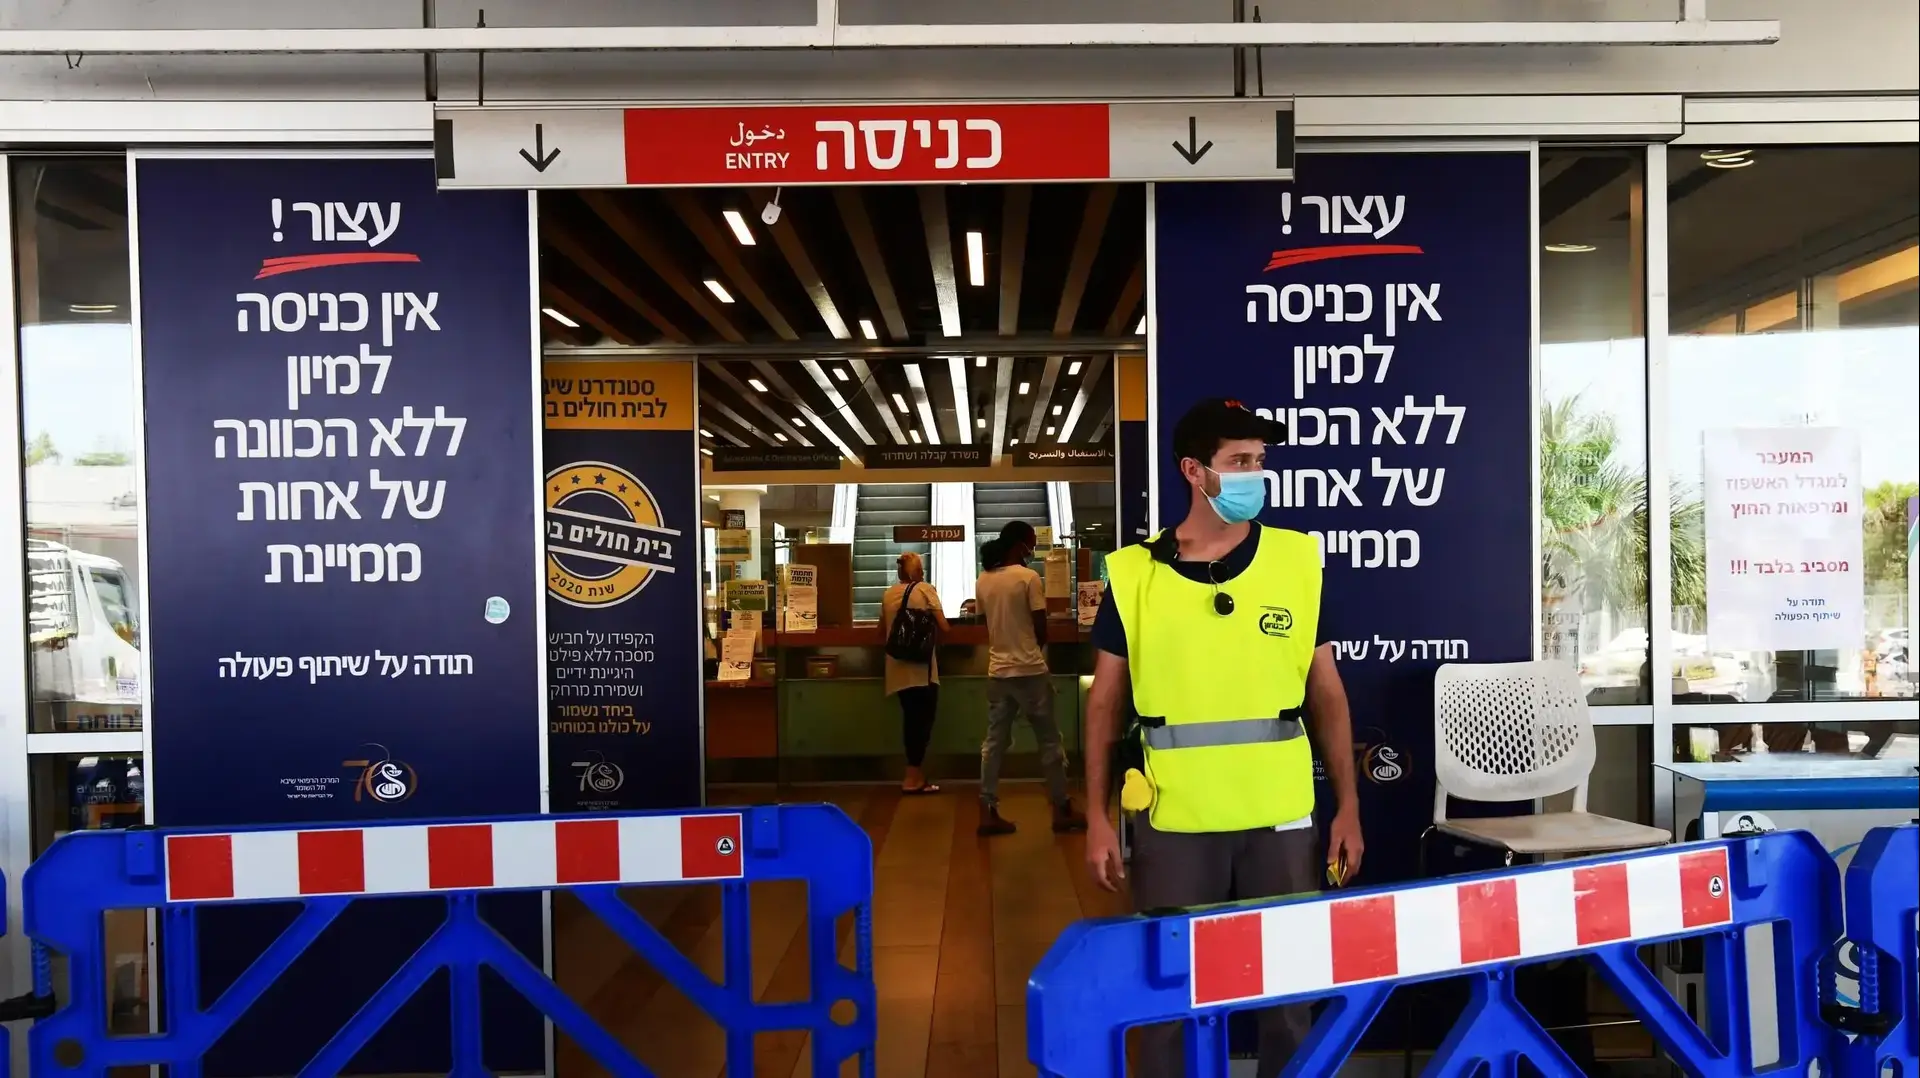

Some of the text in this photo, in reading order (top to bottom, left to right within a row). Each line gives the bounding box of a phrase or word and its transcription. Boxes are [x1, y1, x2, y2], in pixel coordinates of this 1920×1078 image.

[730, 121, 786, 147] دخول
[815, 118, 1003, 170] כניסה
[725, 152, 790, 170] ENTRY
[292, 202, 401, 247] עצור
[1301, 195, 1406, 240] עצור
[236, 292, 441, 346] אין כניסה
[1245, 283, 1443, 337] אין כניסה
[287, 343, 392, 410] למיון
[1294, 333, 1395, 399] למיון
[578, 379, 655, 396] סטנדרט
[563, 397, 617, 418] חולים
[621, 397, 668, 419] לבית
[1371, 394, 1467, 445] ללא
[213, 406, 467, 458] ללא הכוונה
[881, 449, 979, 464] משרד קבלה ושחרור
[1756, 450, 1814, 465] המעבר
[1371, 457, 1446, 507] של
[1726, 473, 1848, 491] למגדל האשפוז
[237, 469, 446, 521] של אחות
[1730, 500, 1848, 519] ומרפאות החוץ
[569, 524, 630, 552] חולים
[921, 529, 960, 539] עמדה 2
[634, 536, 673, 560] בית
[264, 542, 421, 583] ממיינת
[1730, 560, 1849, 574] מסביב בלבד !!!
[550, 572, 615, 597] שנת 2020
[1786, 598, 1825, 608] תודה על
[1774, 612, 1841, 622] שיתוף הפעולה
[586, 629, 604, 646] על
[608, 632, 654, 648] הקפידו
[584, 647, 611, 662] ללא
[614, 650, 655, 662] מסכה
[1373, 635, 1406, 663] על
[1411, 639, 1469, 660] תודה
[218, 649, 473, 684] תודה על שיתוף פעולה
[556, 667, 634, 679] היגיינת ידיים
[550, 684, 643, 700] ושמירת מרחק
[557, 705, 634, 717] ביחד נשמור
[551, 719, 651, 735] על כולנו בטוחים
